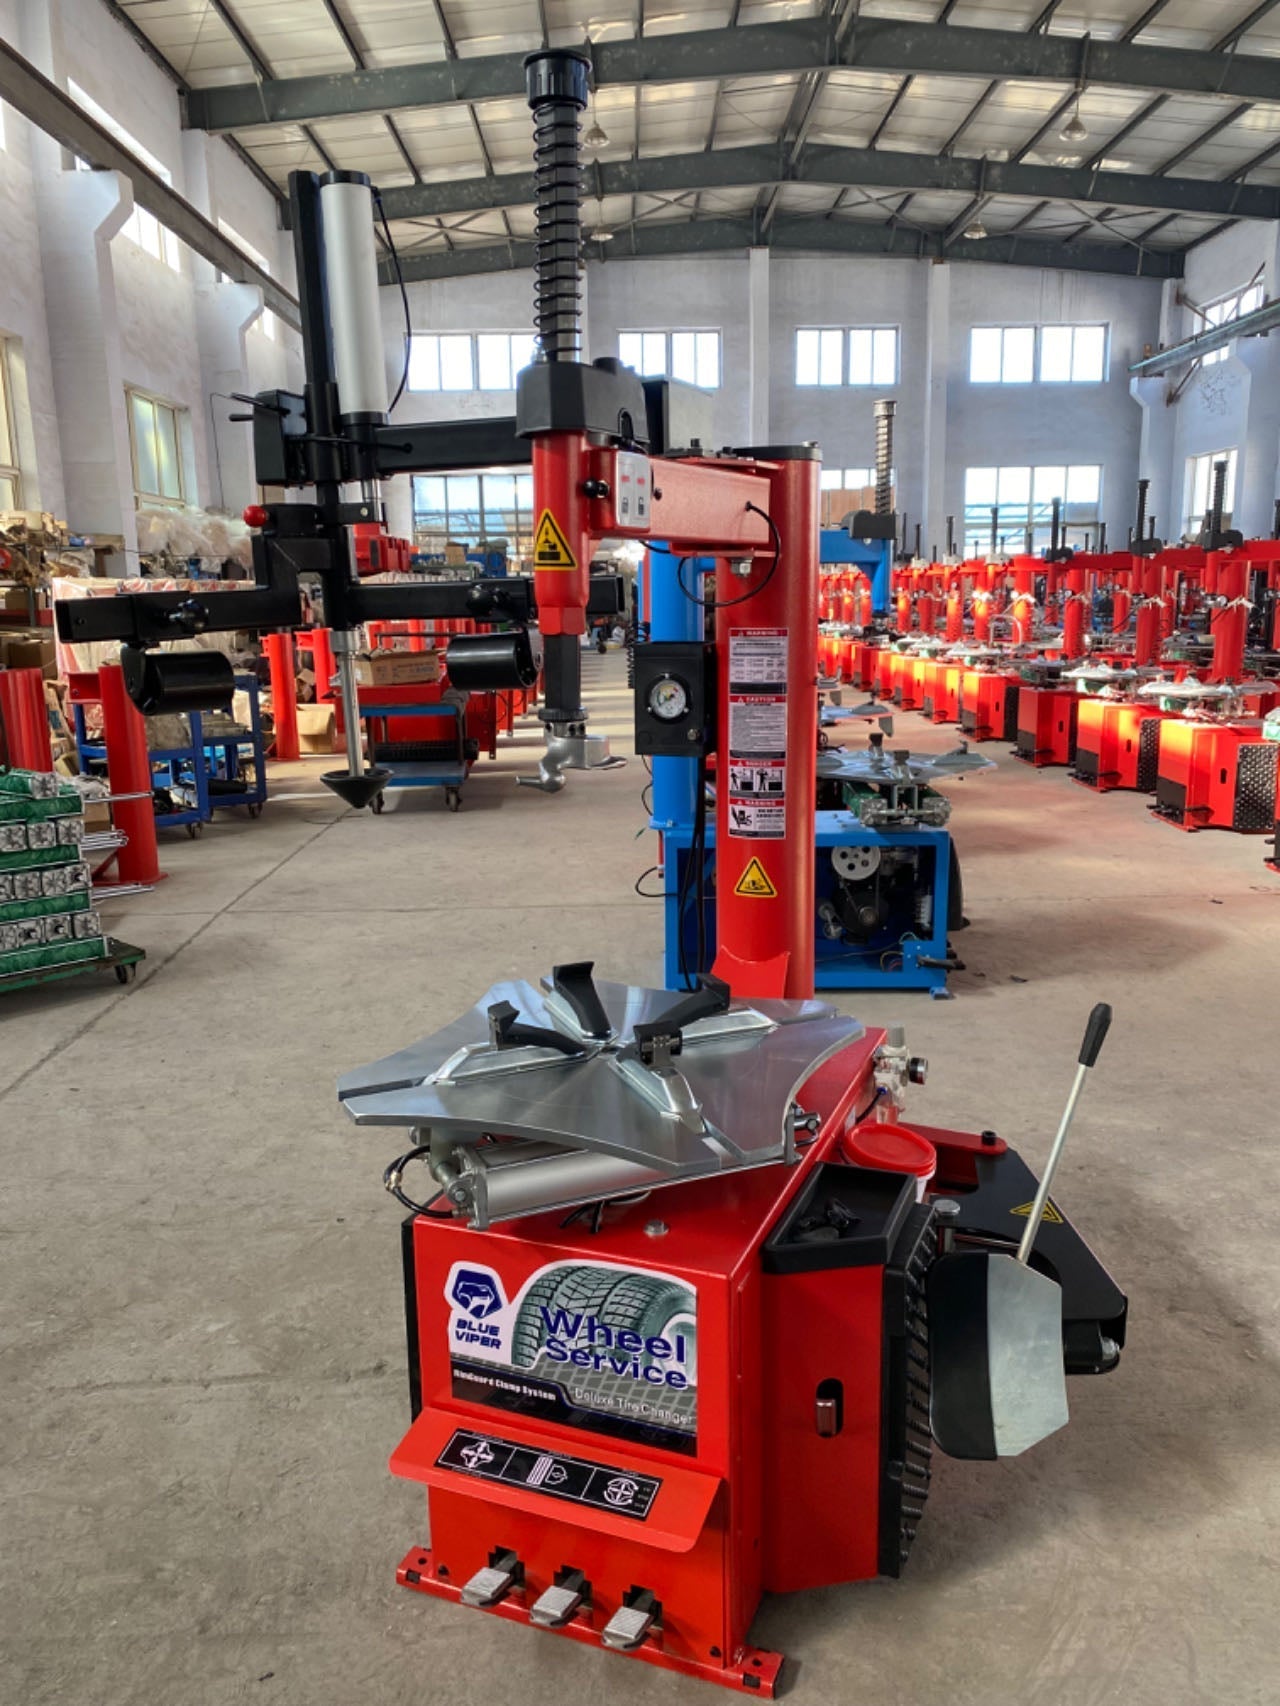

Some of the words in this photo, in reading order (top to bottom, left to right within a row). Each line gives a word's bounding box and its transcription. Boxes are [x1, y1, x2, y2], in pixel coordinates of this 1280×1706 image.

[456, 1318, 500, 1337] BLUE
[539, 1306, 686, 1364] Wheel
[455, 1329, 502, 1350] VIPER
[546, 1337, 688, 1389] Service
[495, 1379, 521, 1393] Clamp
[522, 1385, 556, 1401] System
[575, 1387, 614, 1405] Deluxe
